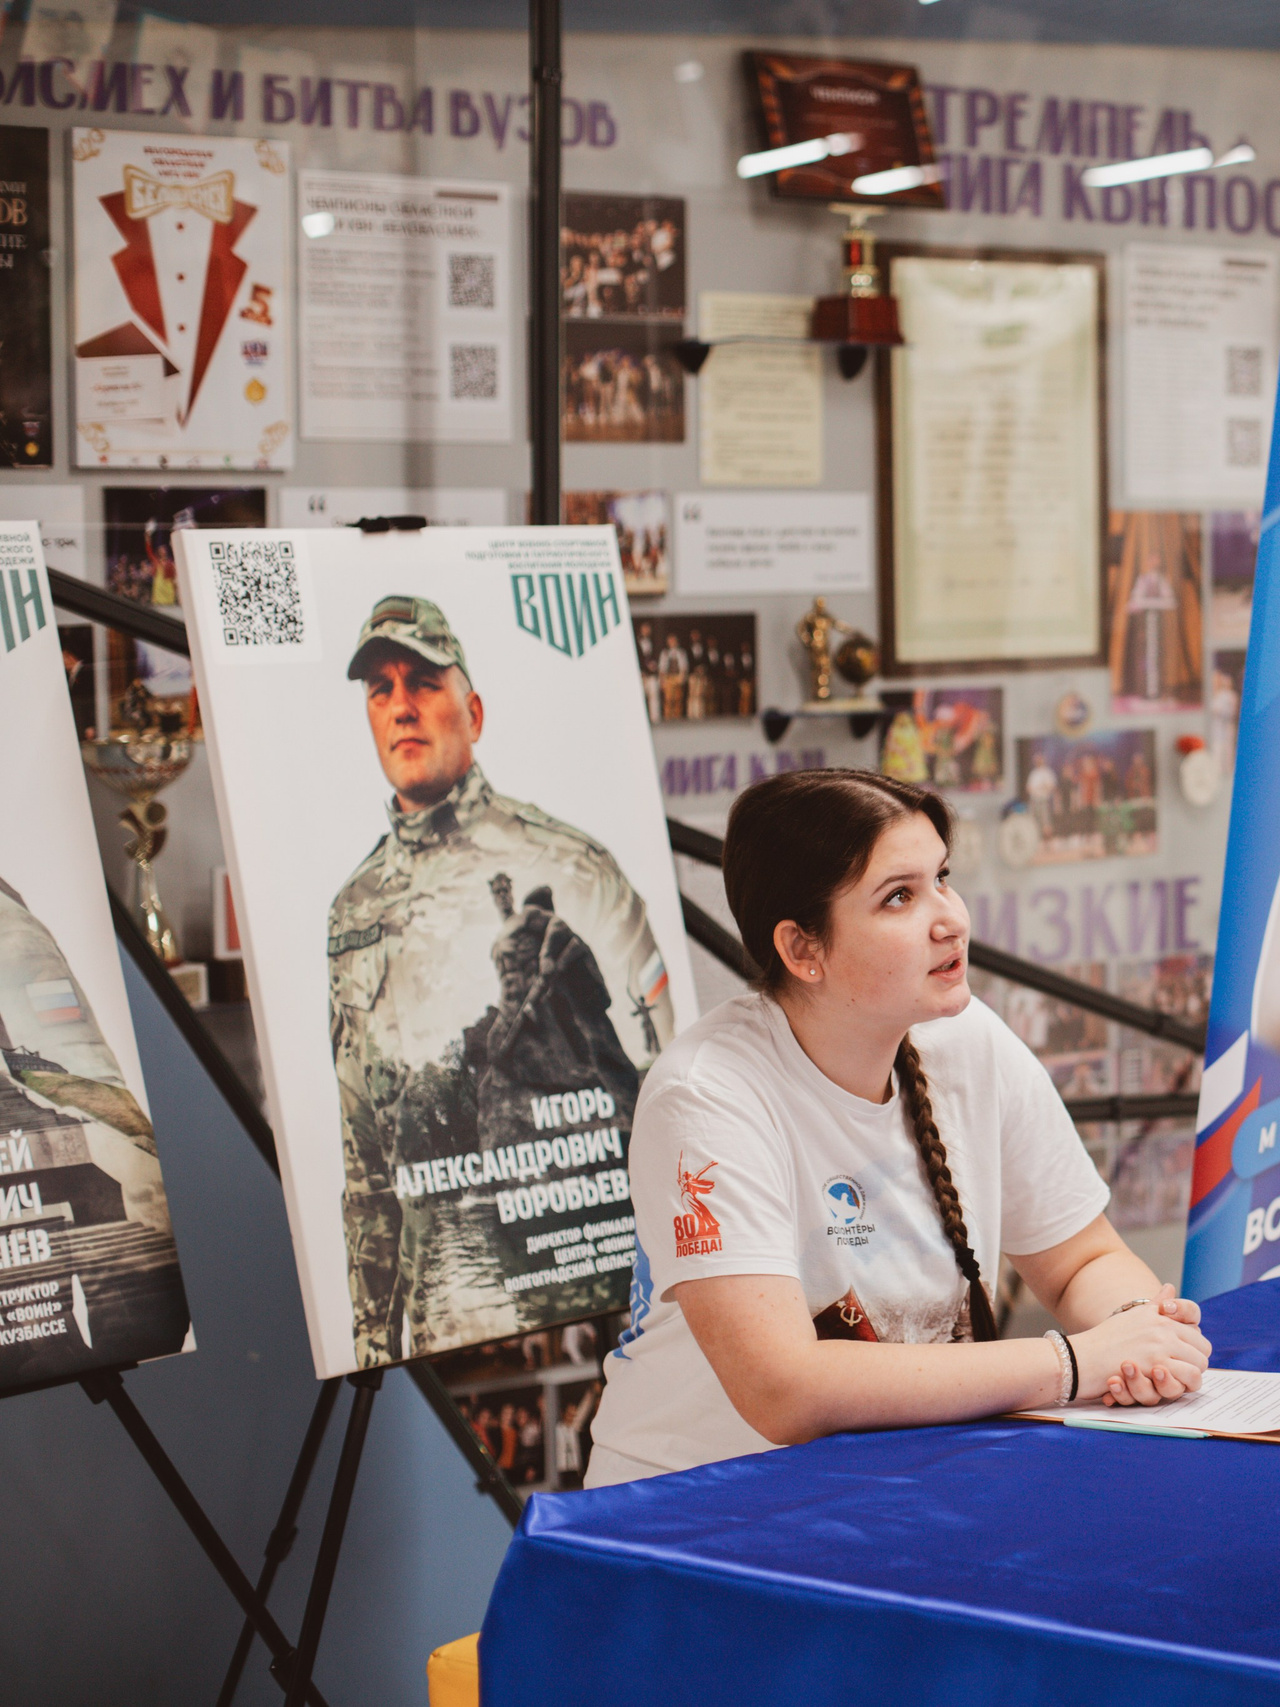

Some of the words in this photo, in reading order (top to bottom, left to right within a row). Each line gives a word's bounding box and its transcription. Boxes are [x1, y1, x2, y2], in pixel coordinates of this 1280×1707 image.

[0, 56, 193, 118] ЛСМЕХ
[211, 69, 244, 121] И
[263, 73, 434, 136] БИТВА
[0, 533, 31, 543] ВНОЙ
[510, 571, 622, 659] ВОИН
[964, 873, 1203, 963] ИЗКИЕ
[530, 1086, 616, 1131] ИГОРЬ
[395, 1125, 624, 1199] АЛЕКСАНДРОВИЧ
[495, 1167, 631, 1225] ВОРОБЬЕВ
[526, 1226, 583, 1255] ДИРЕКТОР
[673, 1213, 696, 1241] 80
[553, 1241, 598, 1265] ЦЕНТРА
[676, 1238, 723, 1258] ПОБЕДА!
[503, 1257, 597, 1294] ВОЛГОГРАДСКОЙ
[0, 1280, 60, 1306] ТРУКТОР
[6, 1300, 63, 1323] «ВОИН»
